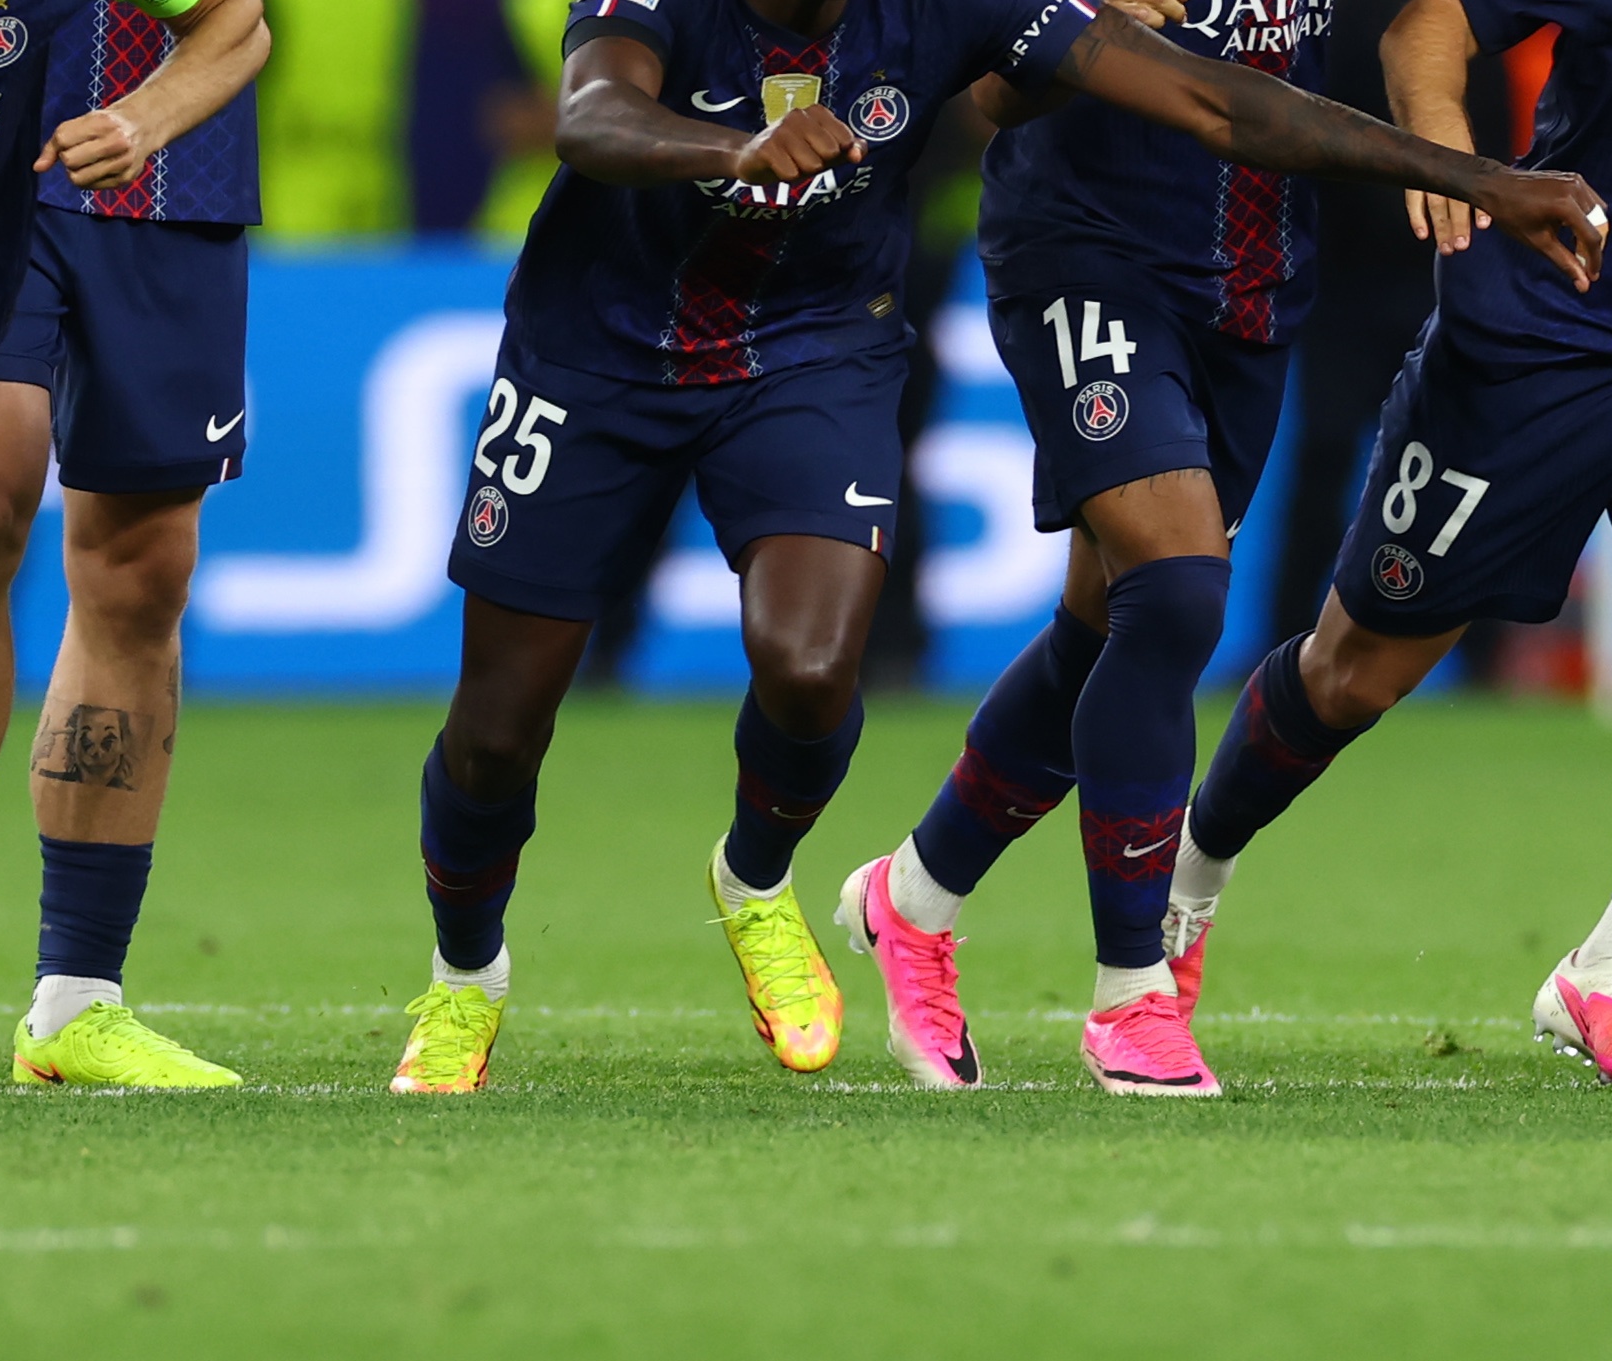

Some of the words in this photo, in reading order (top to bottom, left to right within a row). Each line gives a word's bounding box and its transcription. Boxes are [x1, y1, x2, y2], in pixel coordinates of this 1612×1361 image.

[1220, 8, 1332, 56] AIRWAY
[858, 88, 897, 104] PARIS
[1043, 297, 1137, 389] 14
[1079, 384, 1115, 404] PARIS
[474, 377, 568, 495] 25
[480, 489, 504, 511] PARIS
[1382, 441, 1491, 558] 87
[1384, 547, 1419, 570] PARIS
